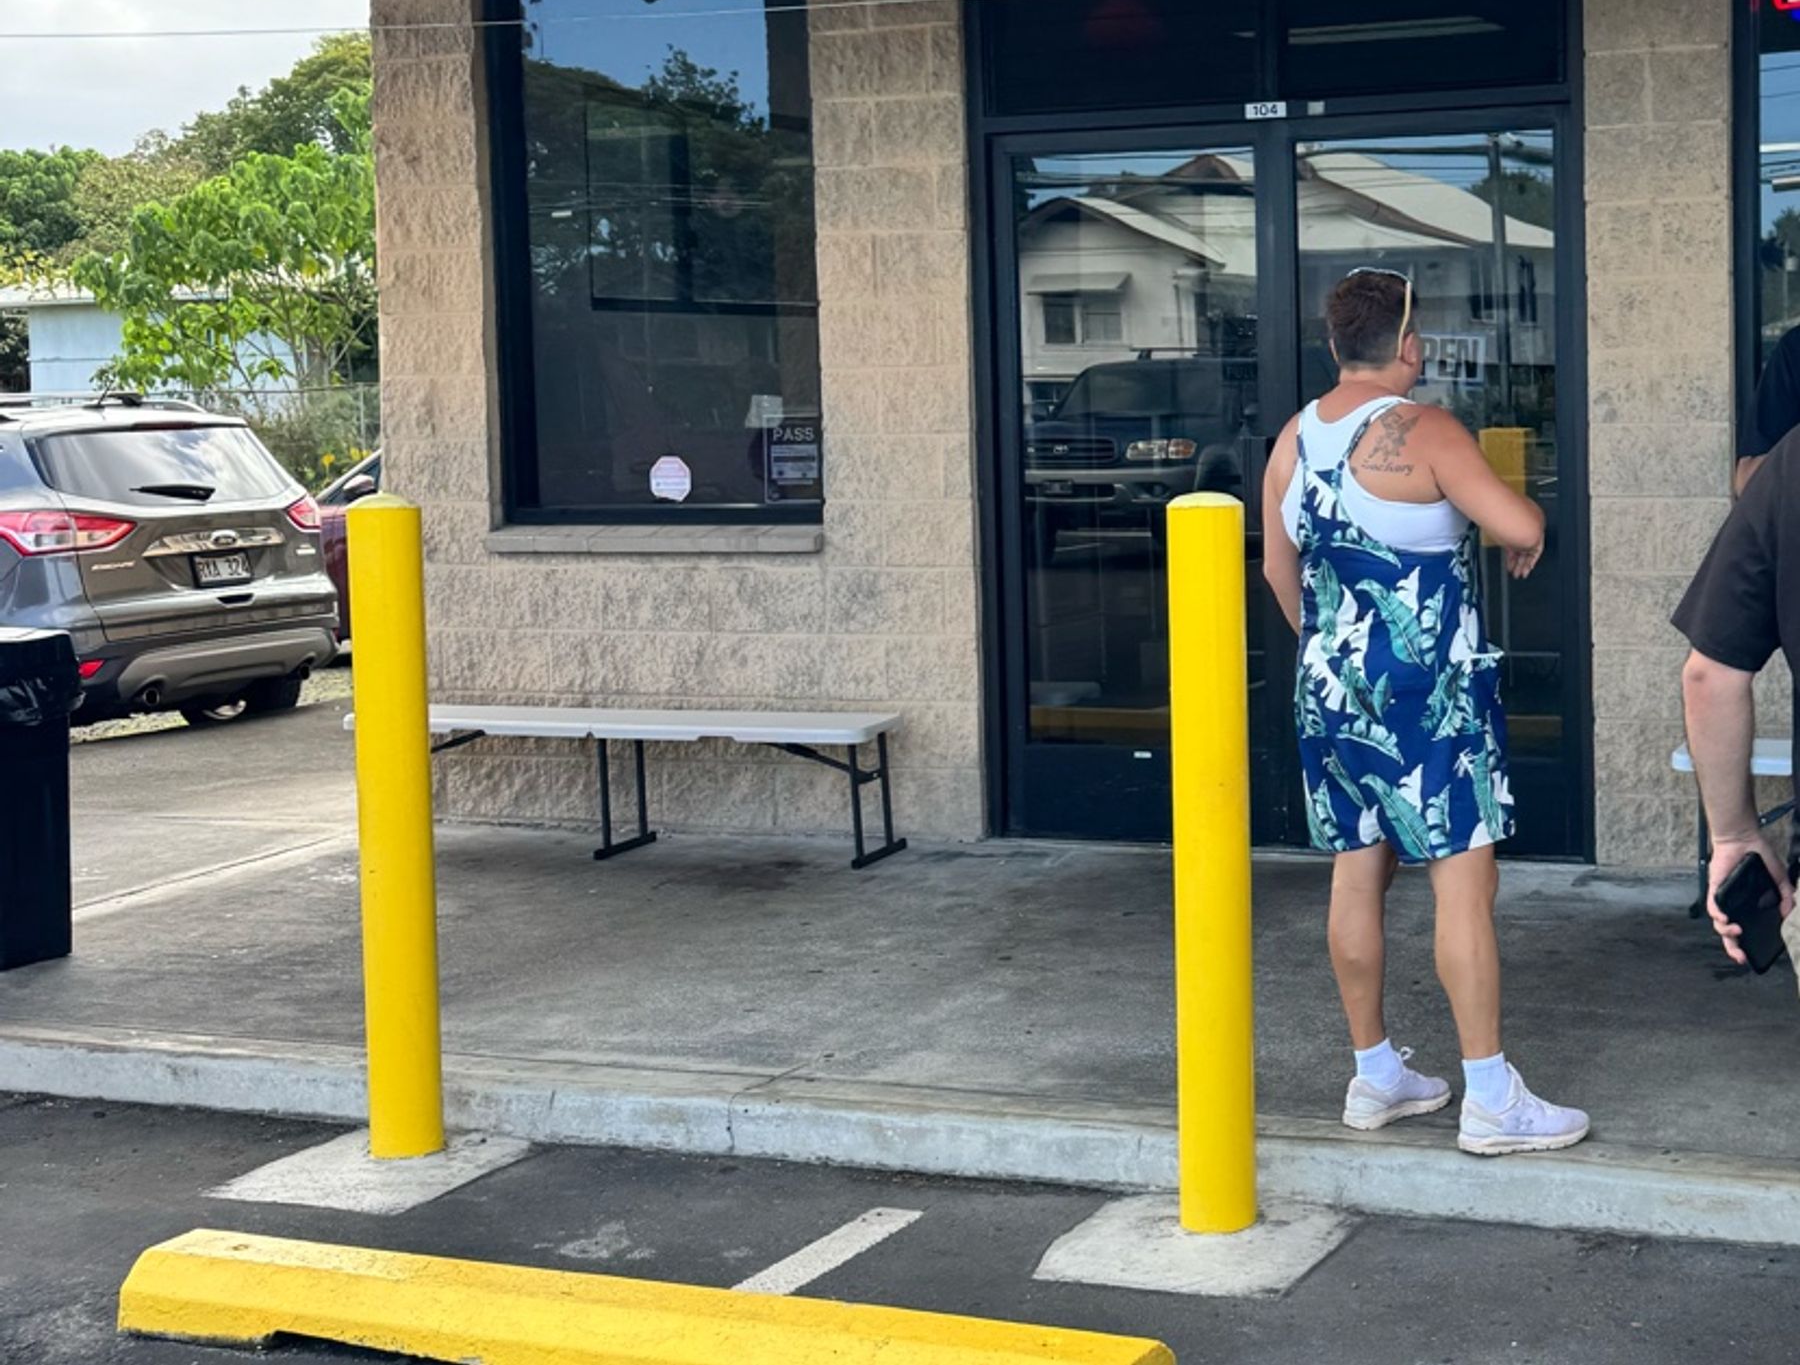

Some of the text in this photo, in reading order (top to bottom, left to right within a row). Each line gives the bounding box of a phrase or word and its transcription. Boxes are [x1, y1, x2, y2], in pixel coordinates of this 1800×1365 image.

[1253, 104, 1278, 116] 104
[1417, 337, 1480, 380] PEN
[773, 427, 815, 442] PASS
